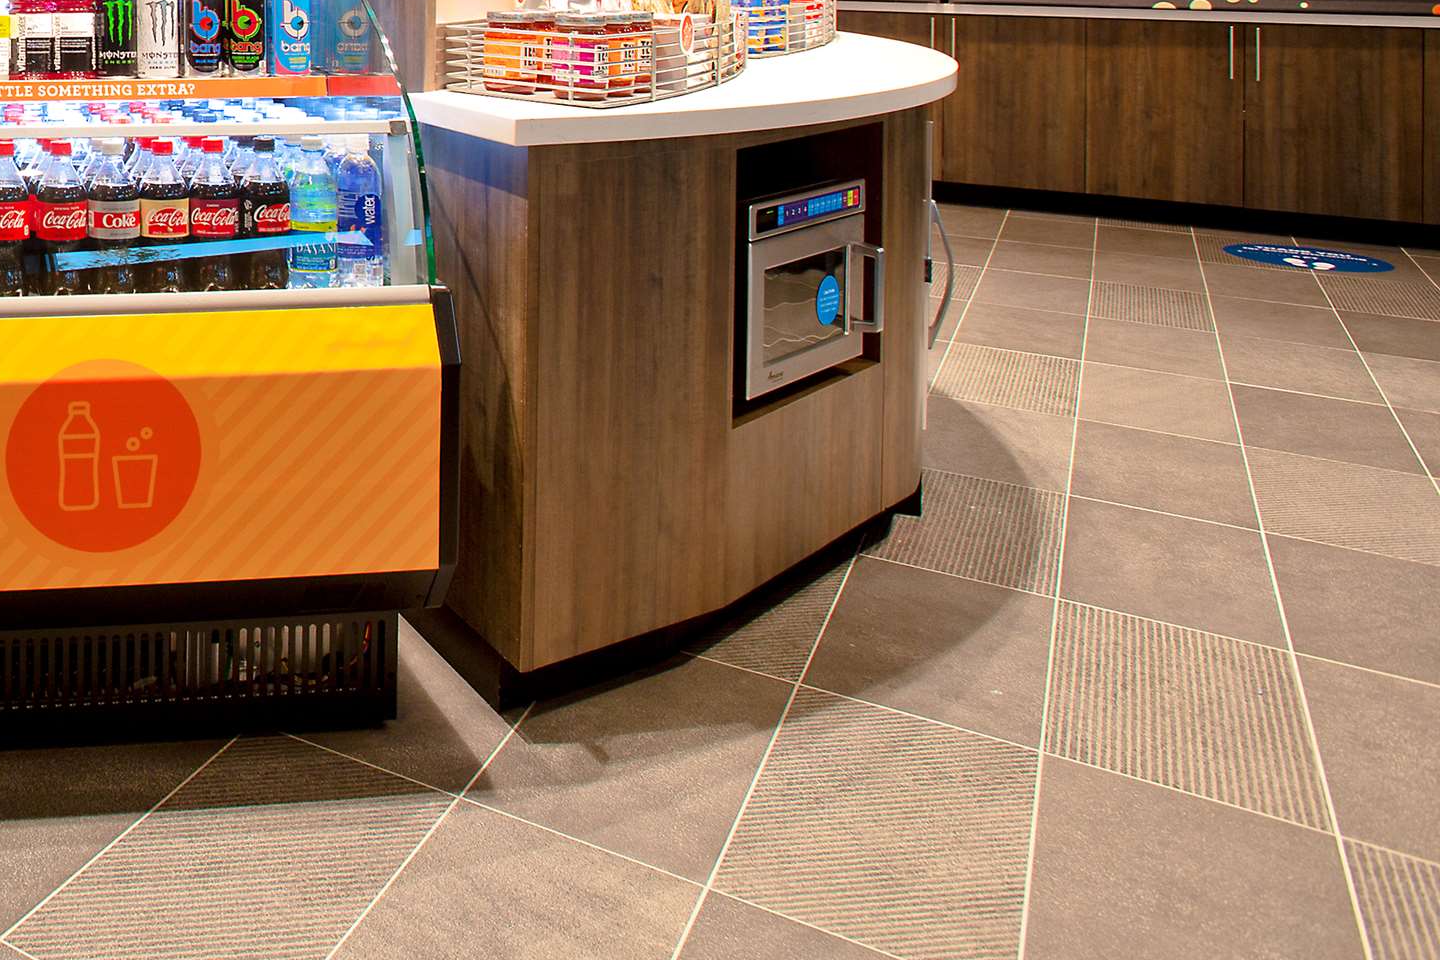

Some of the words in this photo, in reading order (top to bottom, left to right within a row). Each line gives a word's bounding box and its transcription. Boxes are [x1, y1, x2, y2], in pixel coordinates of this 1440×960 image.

[190, 40, 221, 55] bang
[37, 83, 133, 97] SOMETHING
[137, 82, 196, 96] EXTRA?
[191, 207, 235, 226] Coca-Cola
[363, 196, 376, 225] water
[102, 213, 136, 228] Coke
